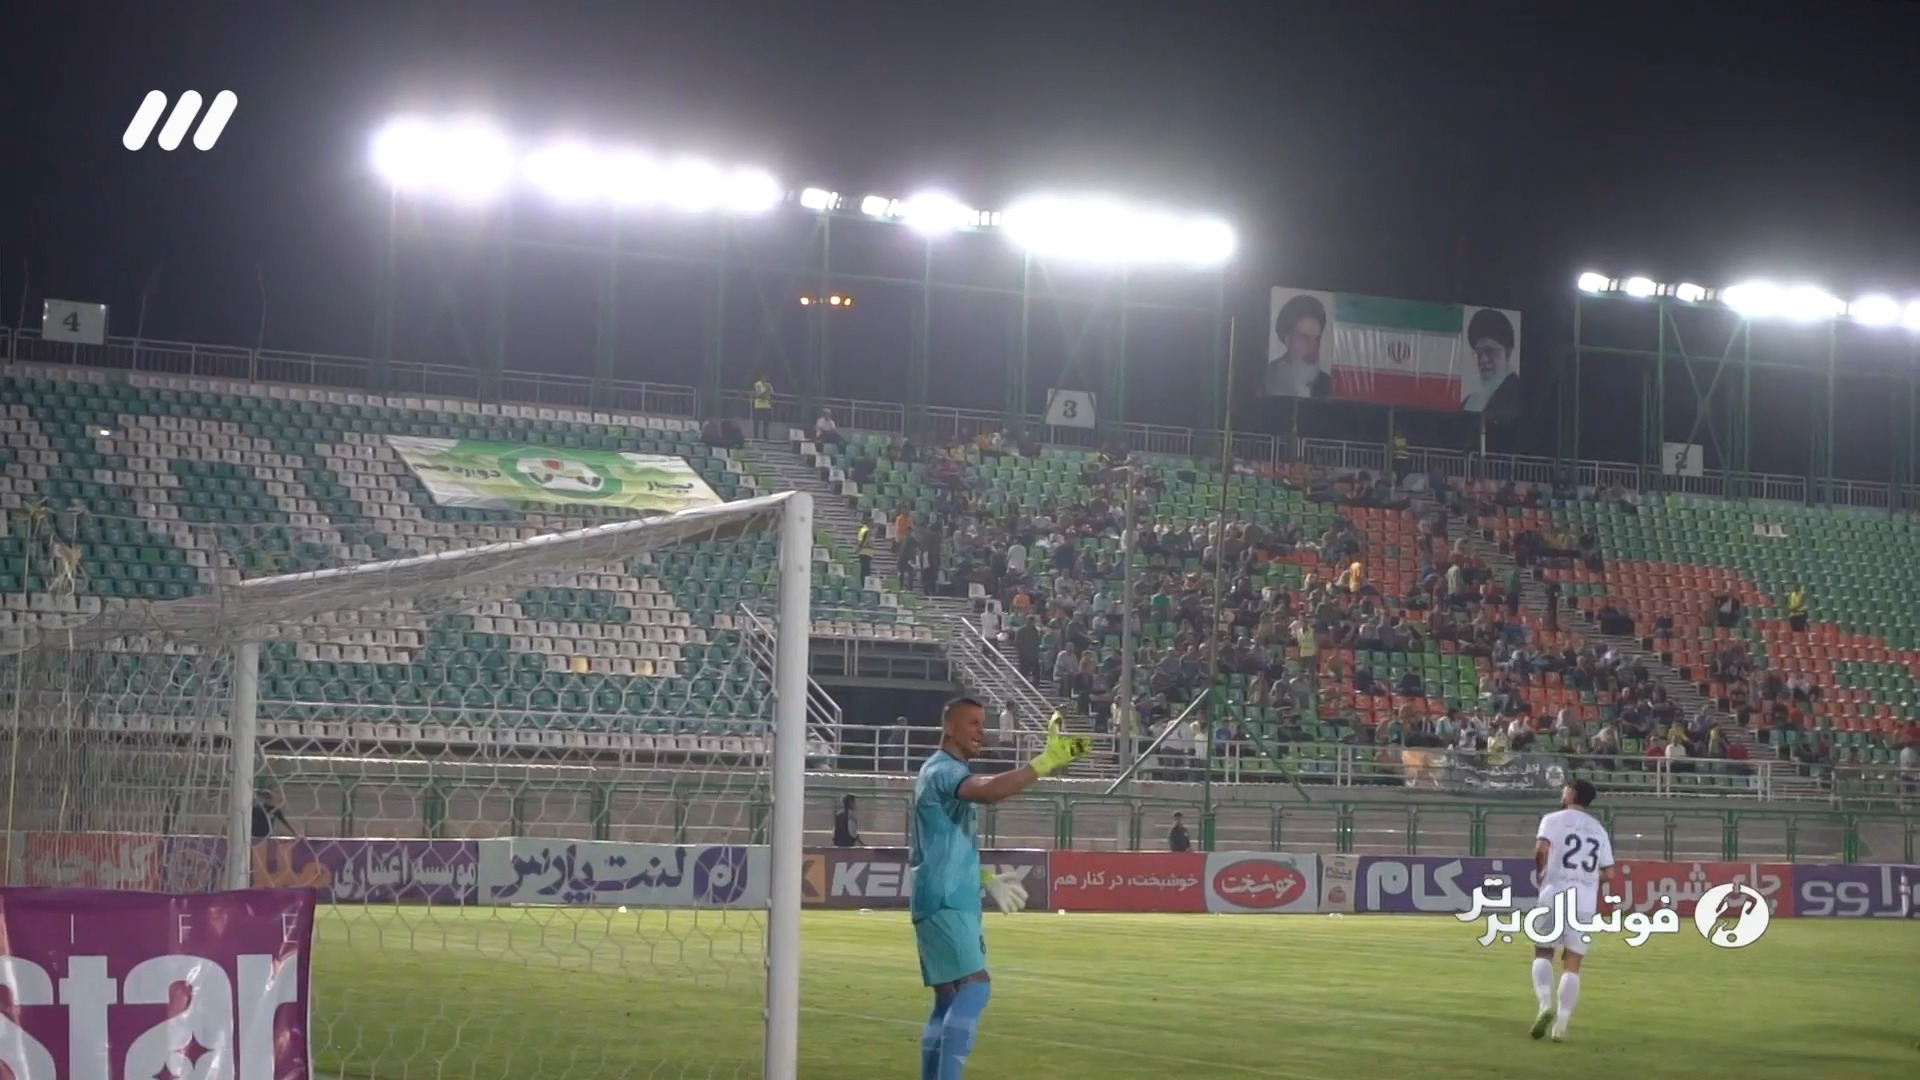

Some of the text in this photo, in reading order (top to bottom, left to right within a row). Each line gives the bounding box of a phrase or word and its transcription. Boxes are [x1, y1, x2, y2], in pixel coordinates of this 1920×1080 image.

[62, 311, 81, 332] 4
[1063, 399, 1078, 419] 3
[1562, 833, 1600, 872] 23
[1053, 872, 1076, 890] هم
[1079, 871, 1106, 889] کنار
[1109, 874, 1124, 888] در
[1220, 871, 1297, 899] خوشبخت
